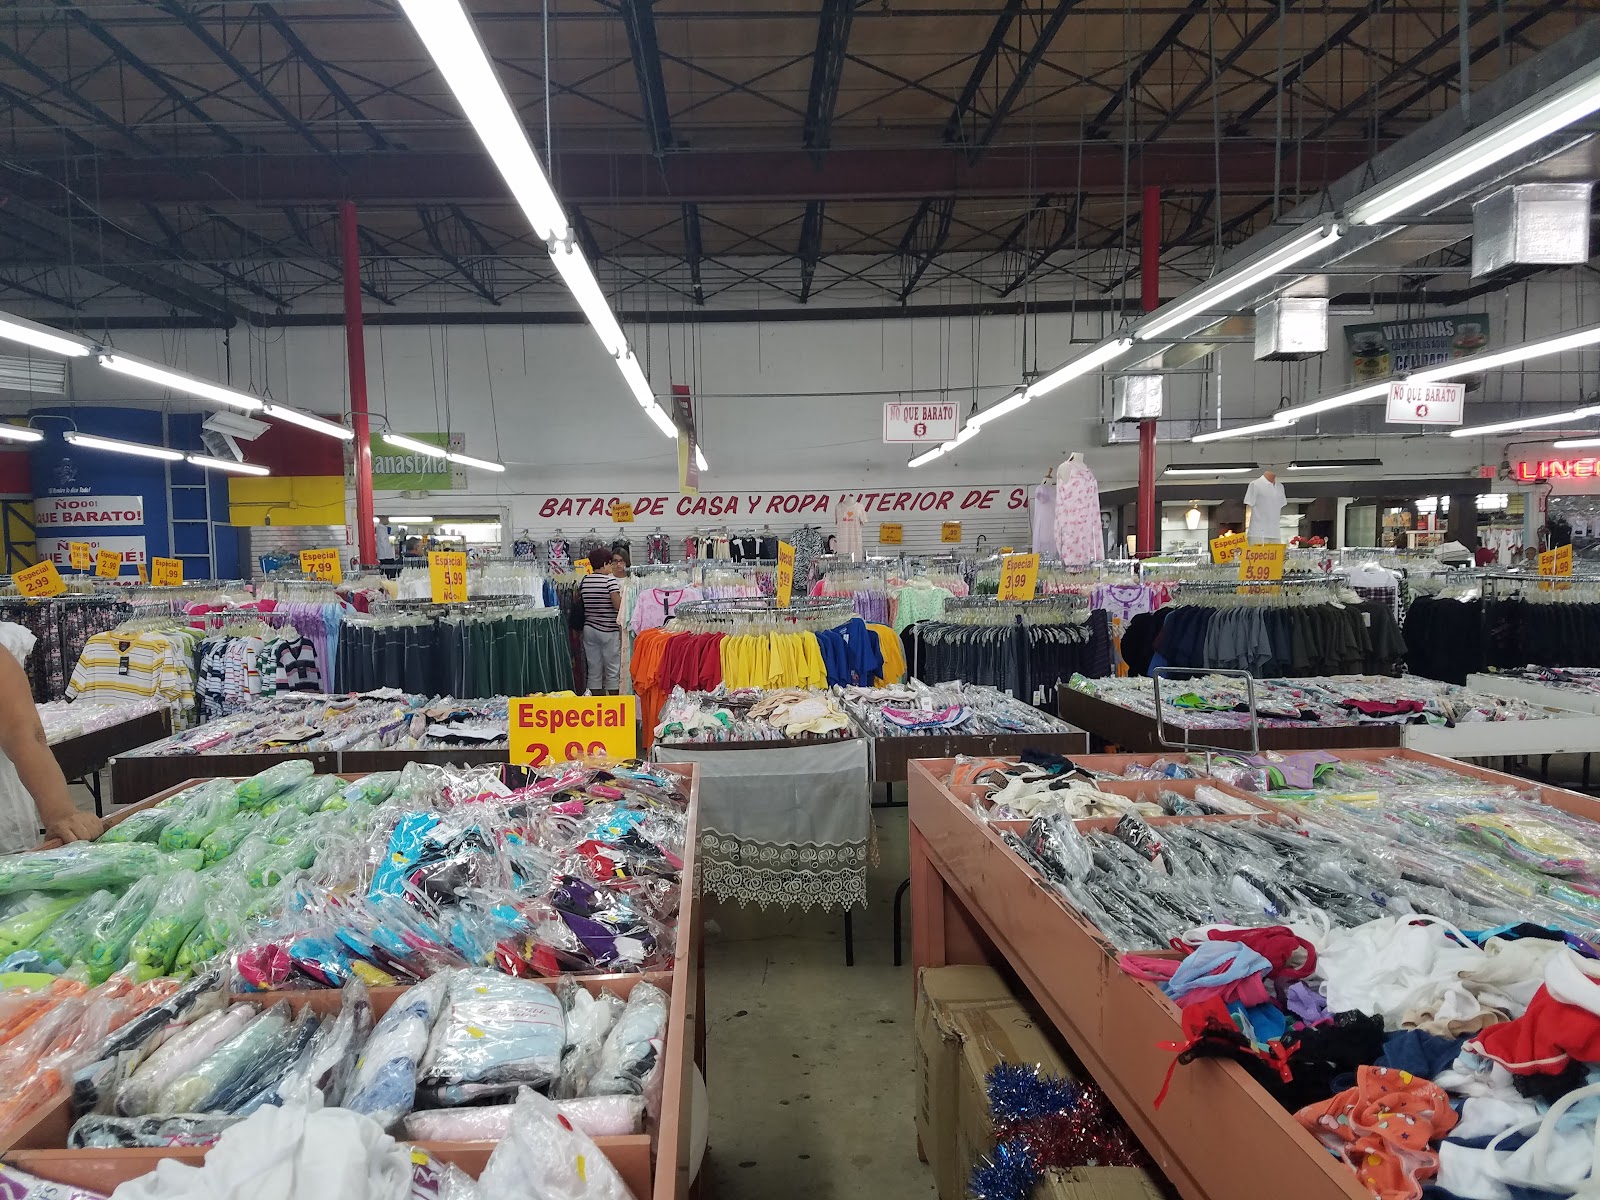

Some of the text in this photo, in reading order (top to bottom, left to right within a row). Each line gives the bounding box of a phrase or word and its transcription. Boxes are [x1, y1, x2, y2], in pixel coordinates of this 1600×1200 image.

[1382, 320, 1455, 340] VITAMINAS
[1407, 388, 1422, 404] QUE
[1425, 388, 1456, 402] BARATO
[903, 407, 919, 423] QUE
[922, 406, 953, 421] BARATO
[915, 423, 926, 437] 5
[371, 450, 447, 475] anastilla
[1518, 459, 1600, 478] LINE
[539, 497, 620, 518] BATAS
[633, 497, 668, 515] DE
[676, 495, 739, 516] CASA
[748, 495, 761, 514] Y
[765, 494, 830, 514] ROPA
[960, 489, 1000, 510] DE
[1007, 488, 1028, 509] S
[36, 511, 142, 524] QUE BARATO!
[1213, 535, 1246, 549] Especial
[101, 550, 119, 560] Especial
[302, 551, 337, 561] Especial
[435, 555, 463, 568] Especial
[1245, 550, 1277, 562] Especial
[1541, 548, 1569, 565] Espcial
[155, 560, 179, 568] Especial
[307, 562, 332, 573] 7.99
[1006, 558, 1034, 571] Especial
[17, 564, 49, 583] Especial
[444, 572, 463, 585] 5.99
[1245, 566, 1270, 580] 5.99
[26, 576, 49, 593] 2.99
[1004, 574, 1027, 589] 399
[518, 703, 626, 733] Especial
[525, 741, 608, 769] 29
